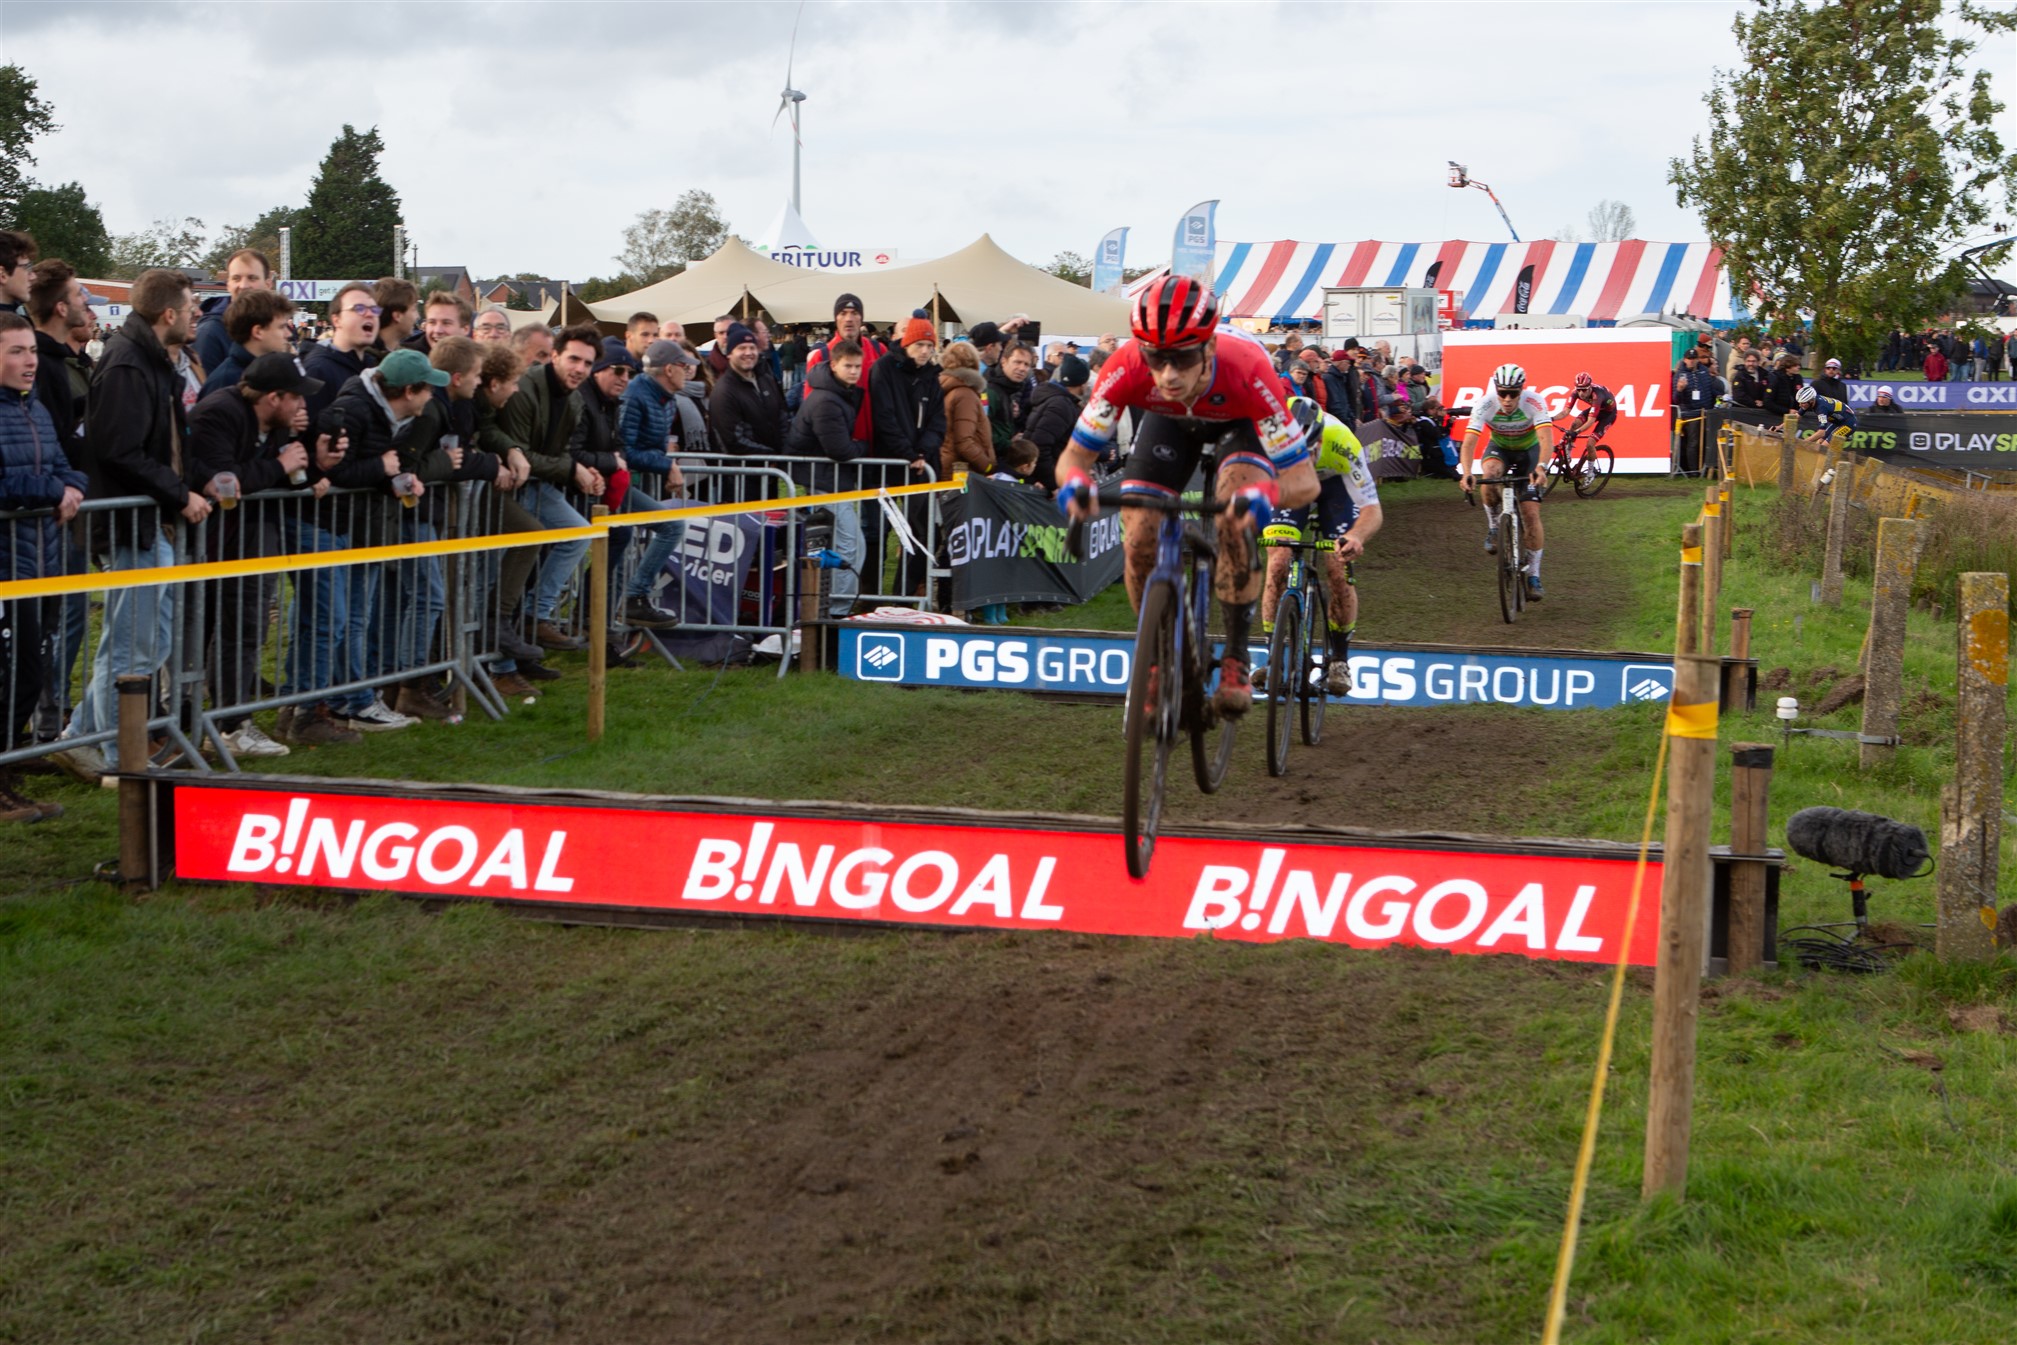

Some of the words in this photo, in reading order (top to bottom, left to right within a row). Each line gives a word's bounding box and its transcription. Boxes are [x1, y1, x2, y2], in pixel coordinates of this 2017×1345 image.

[1187, 235, 1205, 243] PGS
[771, 251, 862, 267] FRITUUR
[280, 281, 316, 299] axi
[1847, 385, 1878, 402] xi
[1898, 385, 1947, 403] axi
[1966, 386, 2017, 404] axi
[1353, 471, 1361, 481] 6
[674, 517, 746, 565] ED
[926, 638, 1029, 683] PGS
[1037, 646, 1130, 685] GRO
[1425, 663, 1596, 706] GROUP
[226, 798, 575, 892] B!NGOAL
[682, 822, 1065, 921] B!NGOAL
[1182, 848, 1604, 952] B!NGOAL
